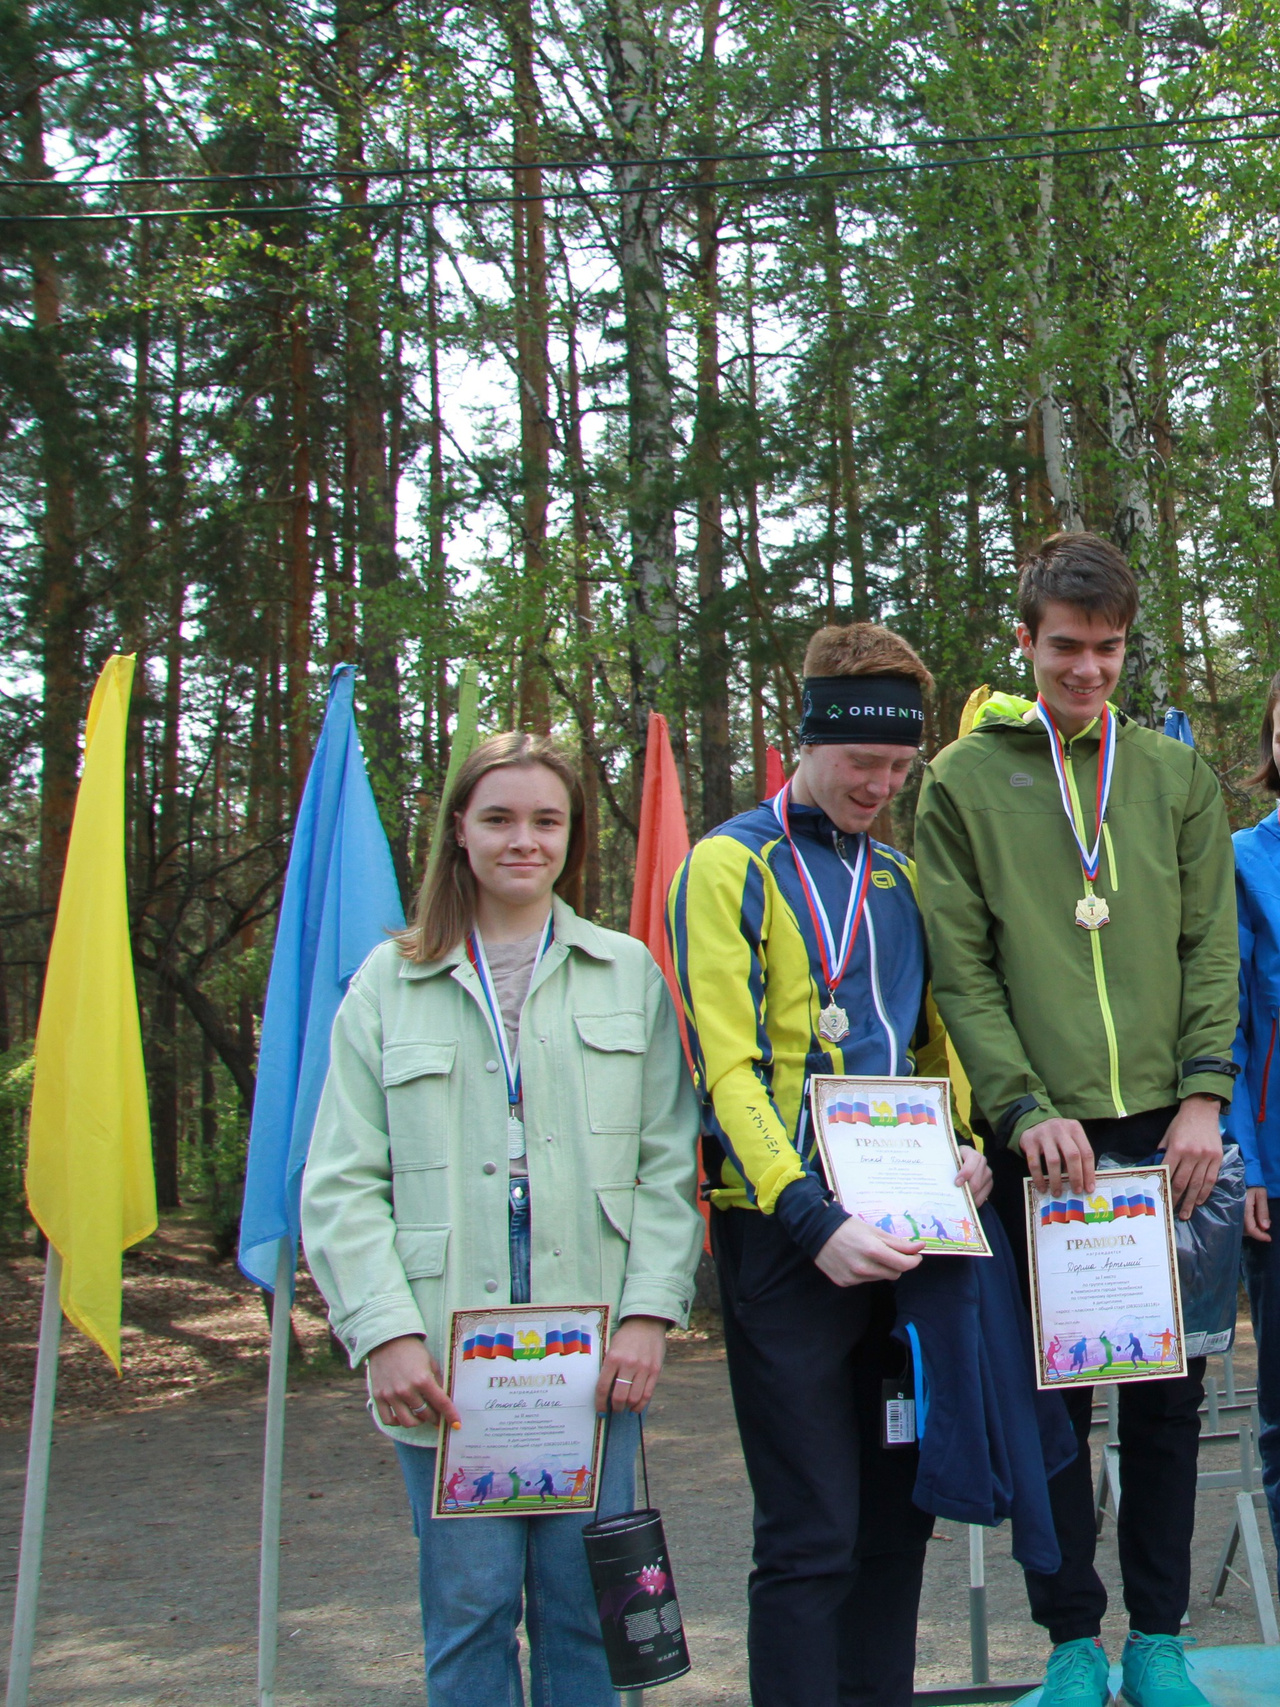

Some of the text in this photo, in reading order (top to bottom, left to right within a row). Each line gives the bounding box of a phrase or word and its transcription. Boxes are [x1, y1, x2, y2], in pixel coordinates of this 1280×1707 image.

[849, 706, 925, 721] ORIENTE
[830, 1018, 838, 1028] 2
[856, 1138, 922, 1148] ГРАМОТА
[1066, 1234, 1137, 1250] ГРАМОТА
[488, 1374, 566, 1388] ГРАМОТА
